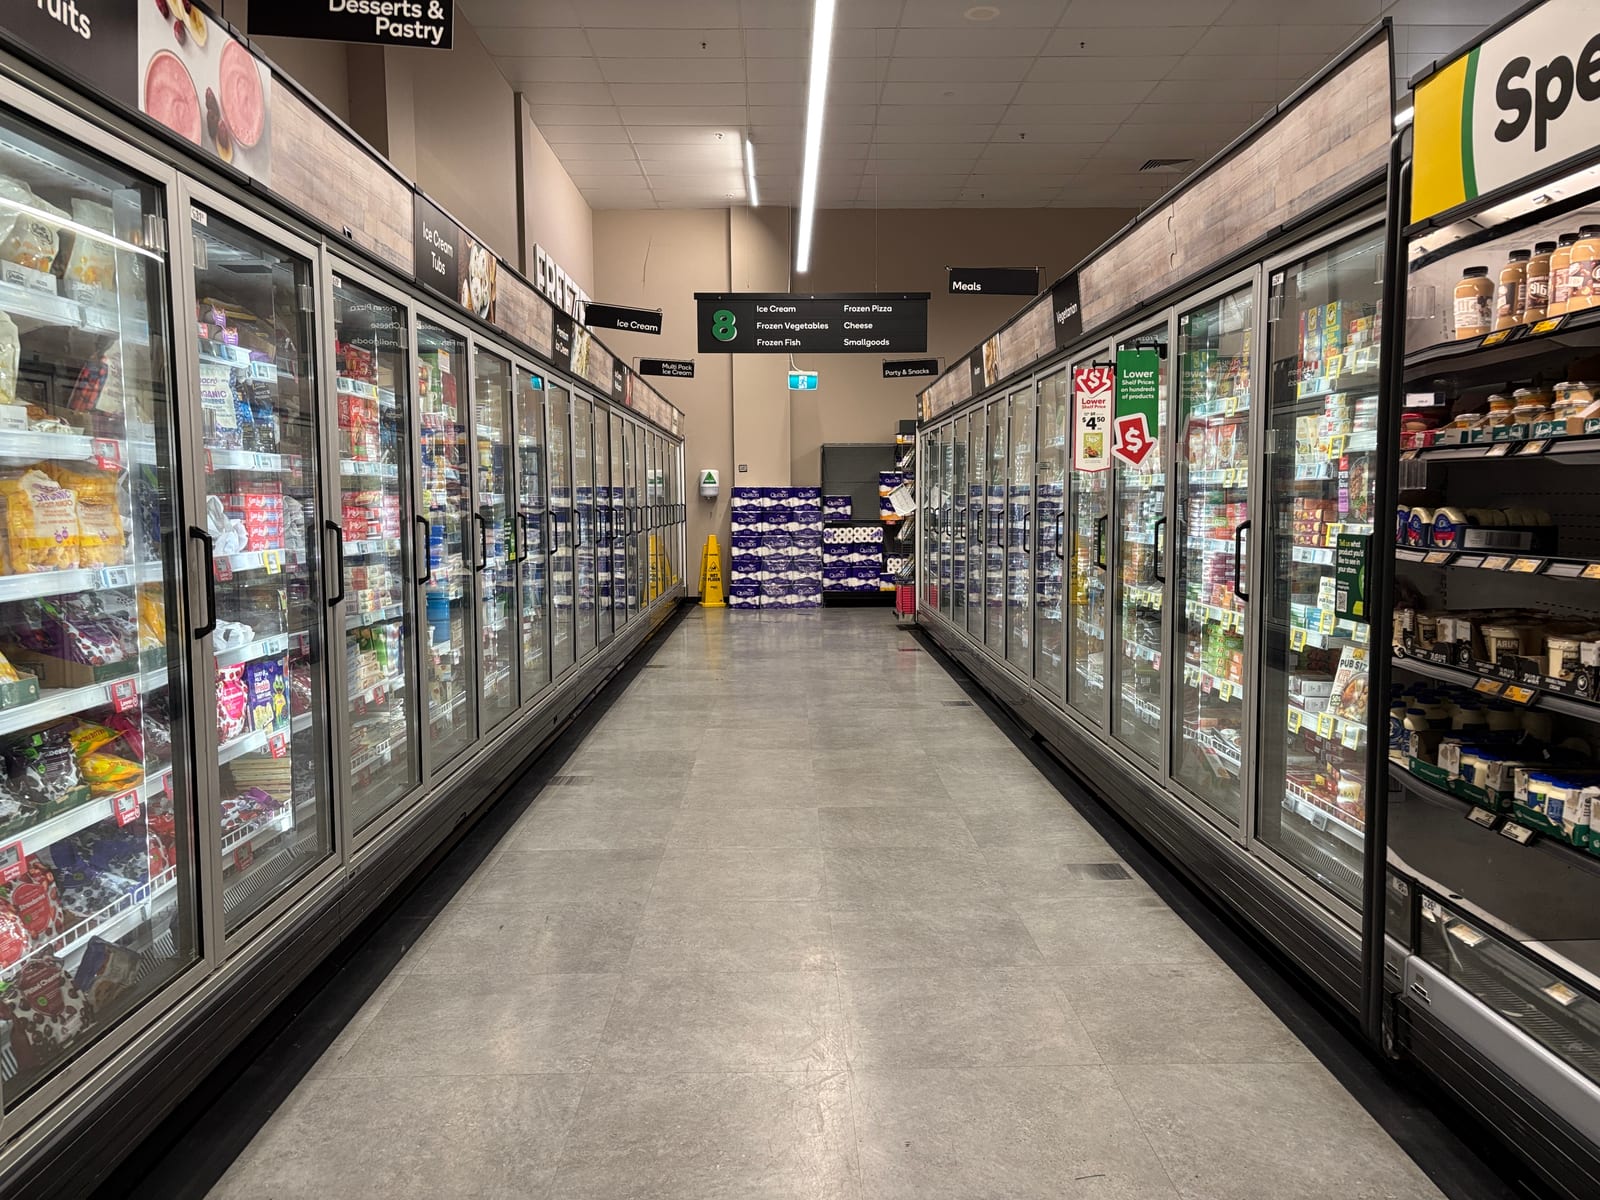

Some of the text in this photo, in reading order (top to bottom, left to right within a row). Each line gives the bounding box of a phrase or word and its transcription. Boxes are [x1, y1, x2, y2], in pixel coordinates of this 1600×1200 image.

[329, 0, 444, 20] Desserts &
[376, 16, 444, 45] Pastry
[1494, 32, 1600, 152] Spe
[423, 220, 454, 258] Ice Cream
[431, 251, 446, 276] Tubs
[952, 281, 982, 291] Meals
[756, 305, 797, 313] Ice Cream
[843, 305, 893, 313] Frozen Pizza
[1055, 303, 1078, 325] Vegetarian
[616, 319, 658, 332] Ice Cream
[712, 309, 738, 342] 8
[756, 322, 829, 332] Frozen Vegetables
[843, 322, 873, 330] Cheese
[756, 338, 801, 347] Frozen Fish
[843, 338, 890, 348] Smallgoods
[661, 362, 693, 371] Multi Pack
[884, 369, 901, 377] Party
[1123, 369, 1154, 379] Lower
[1340, 658, 1369, 672] PUB SIZ
